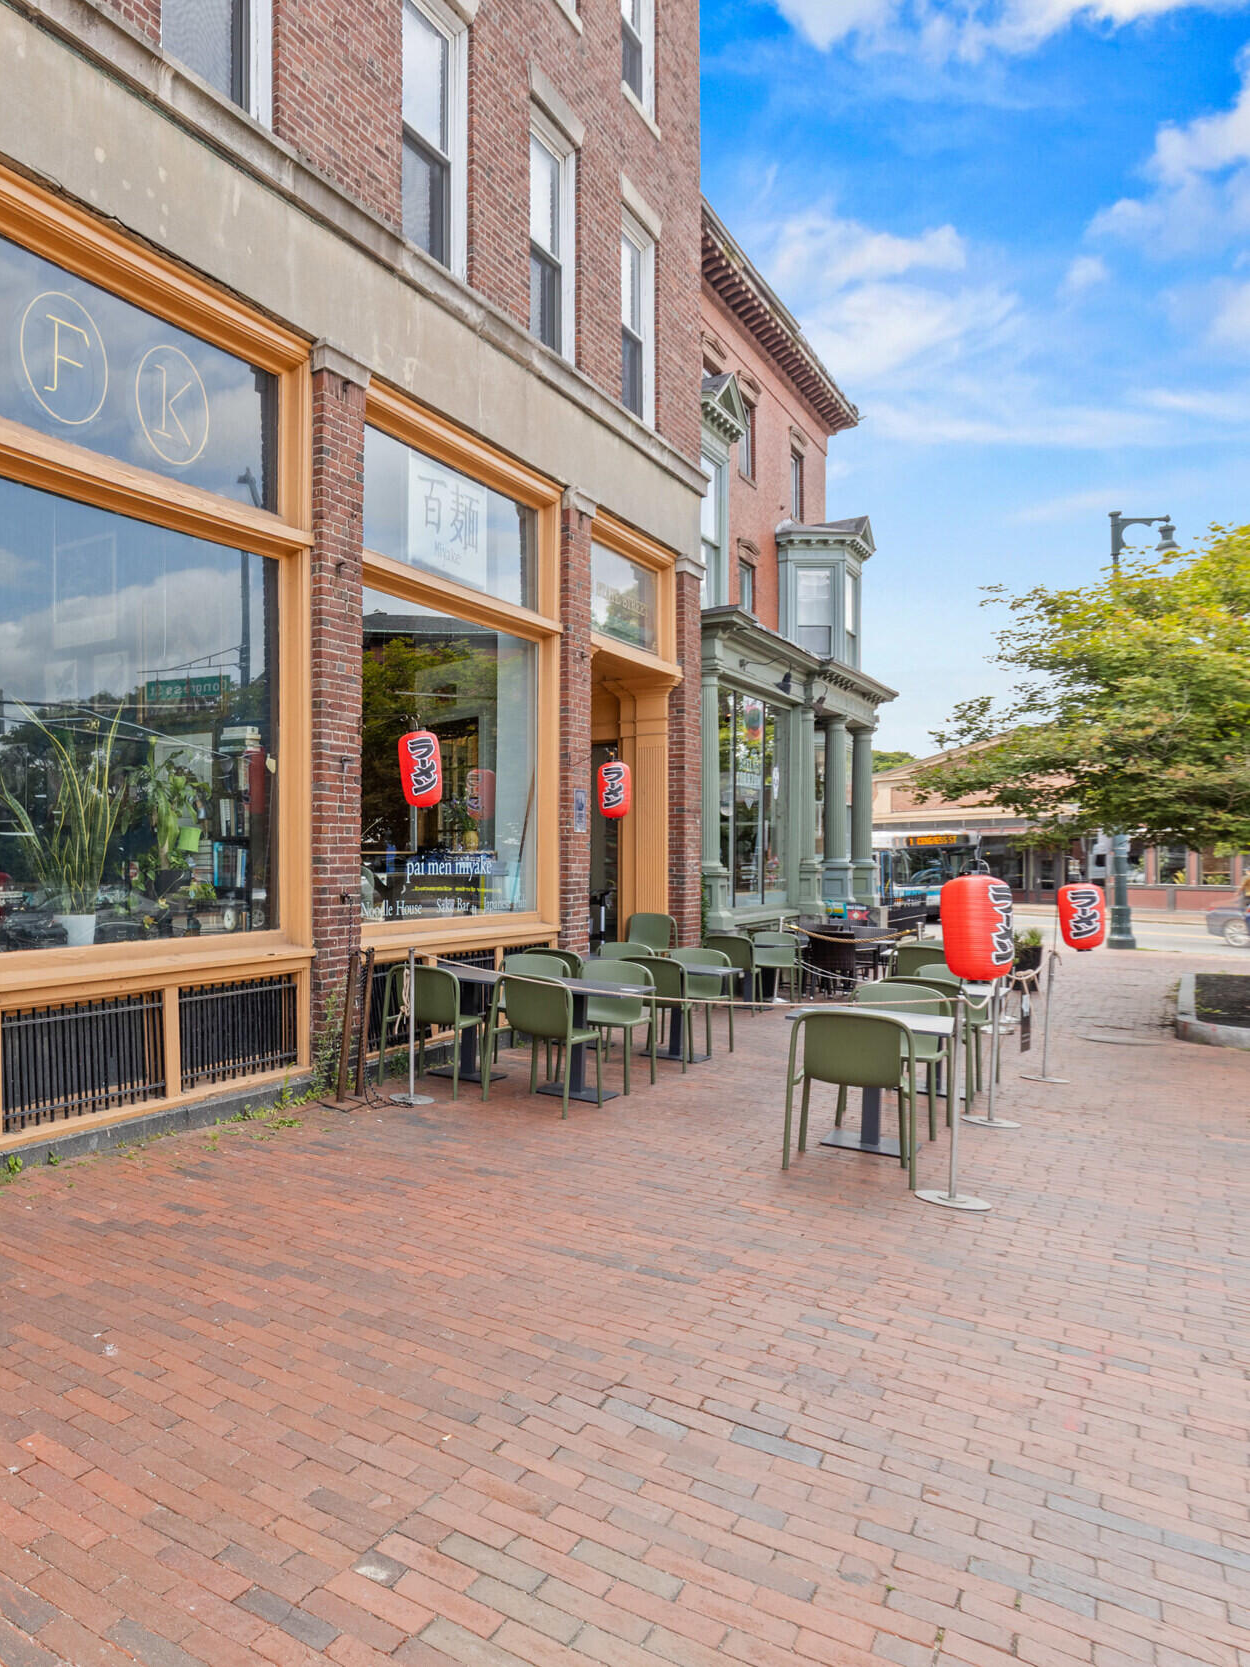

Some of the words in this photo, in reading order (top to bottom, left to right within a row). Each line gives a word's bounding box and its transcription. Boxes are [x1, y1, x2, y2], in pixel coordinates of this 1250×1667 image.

[407, 736, 438, 797] ラーメン
[602, 765, 625, 810] ラーメン
[406, 855, 425, 884] pai
[427, 860, 452, 875] men
[455, 854, 492, 882] miyake
[360, 899, 393, 919] Noodle
[396, 899, 423, 916] House
[456, 897, 470, 913] Bar
[1067, 889, 1101, 940] ラーメン
